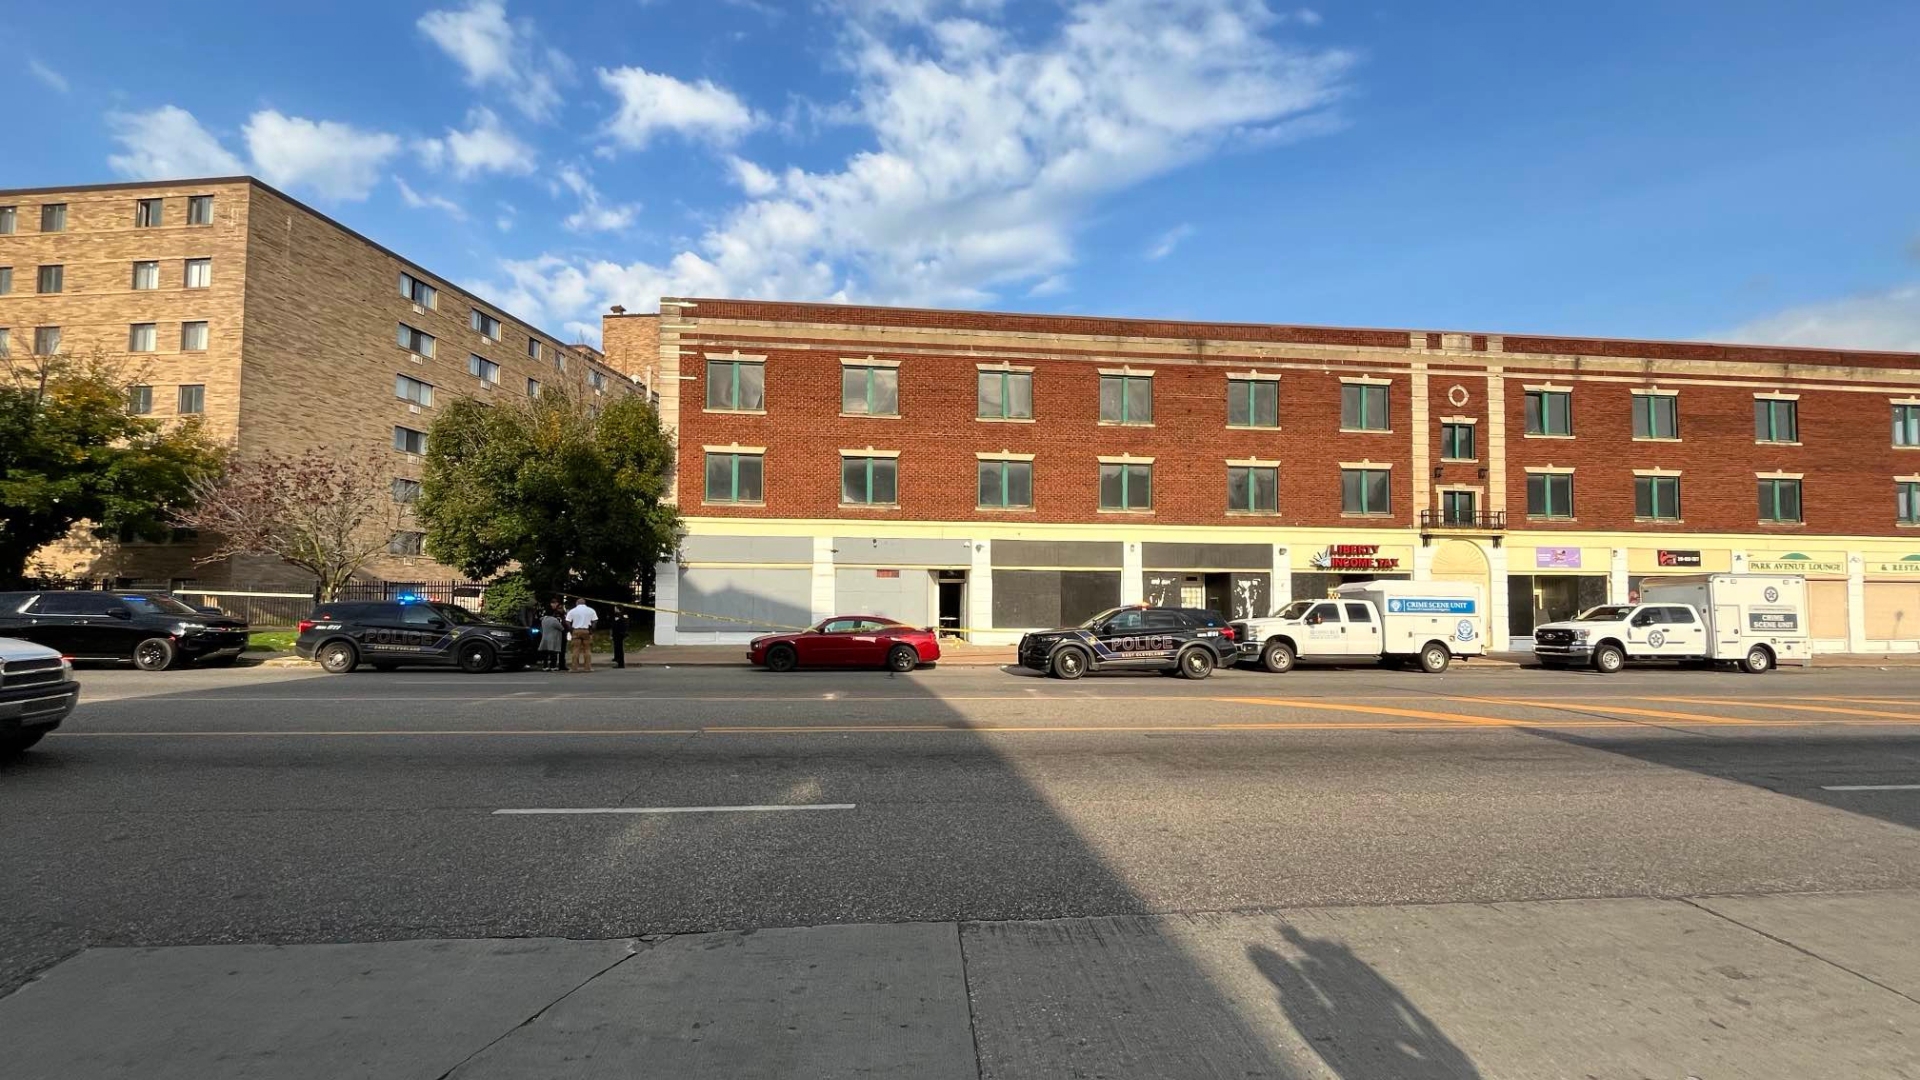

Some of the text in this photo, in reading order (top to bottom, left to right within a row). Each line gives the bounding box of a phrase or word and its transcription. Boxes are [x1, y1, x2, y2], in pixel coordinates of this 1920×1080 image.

[1330, 545, 1379, 554] LIBERTY
[1331, 558, 1399, 568] INCOME TAX
[1750, 562, 1841, 571] PARK AVENUE LOUNGE
[1761, 614, 1785, 622] CRIME
[364, 628, 433, 645] POLICE
[1111, 635, 1174, 651] POLICE
